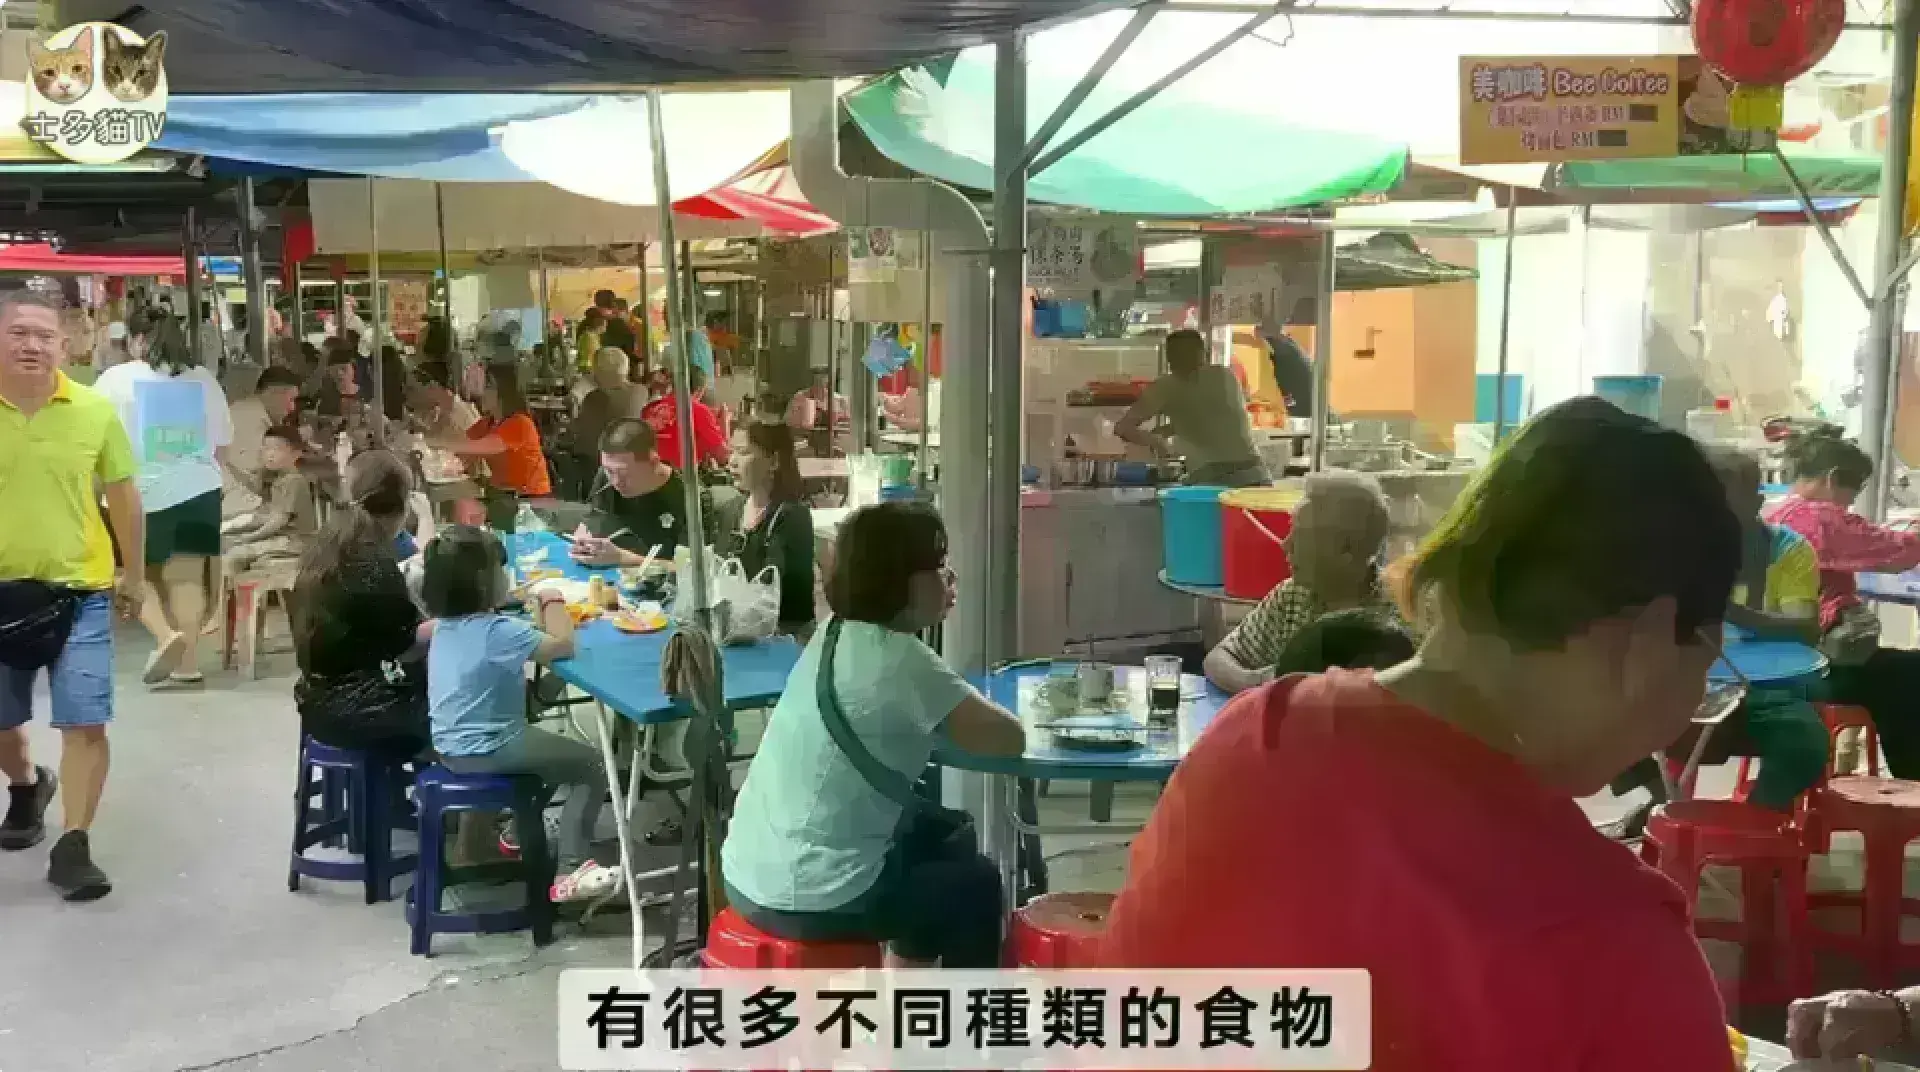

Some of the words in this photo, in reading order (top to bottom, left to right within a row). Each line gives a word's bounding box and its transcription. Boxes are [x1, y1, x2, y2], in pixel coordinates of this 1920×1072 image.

[1472, 63, 1548, 101] 美咖啡
[1553, 68, 1597, 96] Bee
[1600, 67, 1669, 96] Coffee
